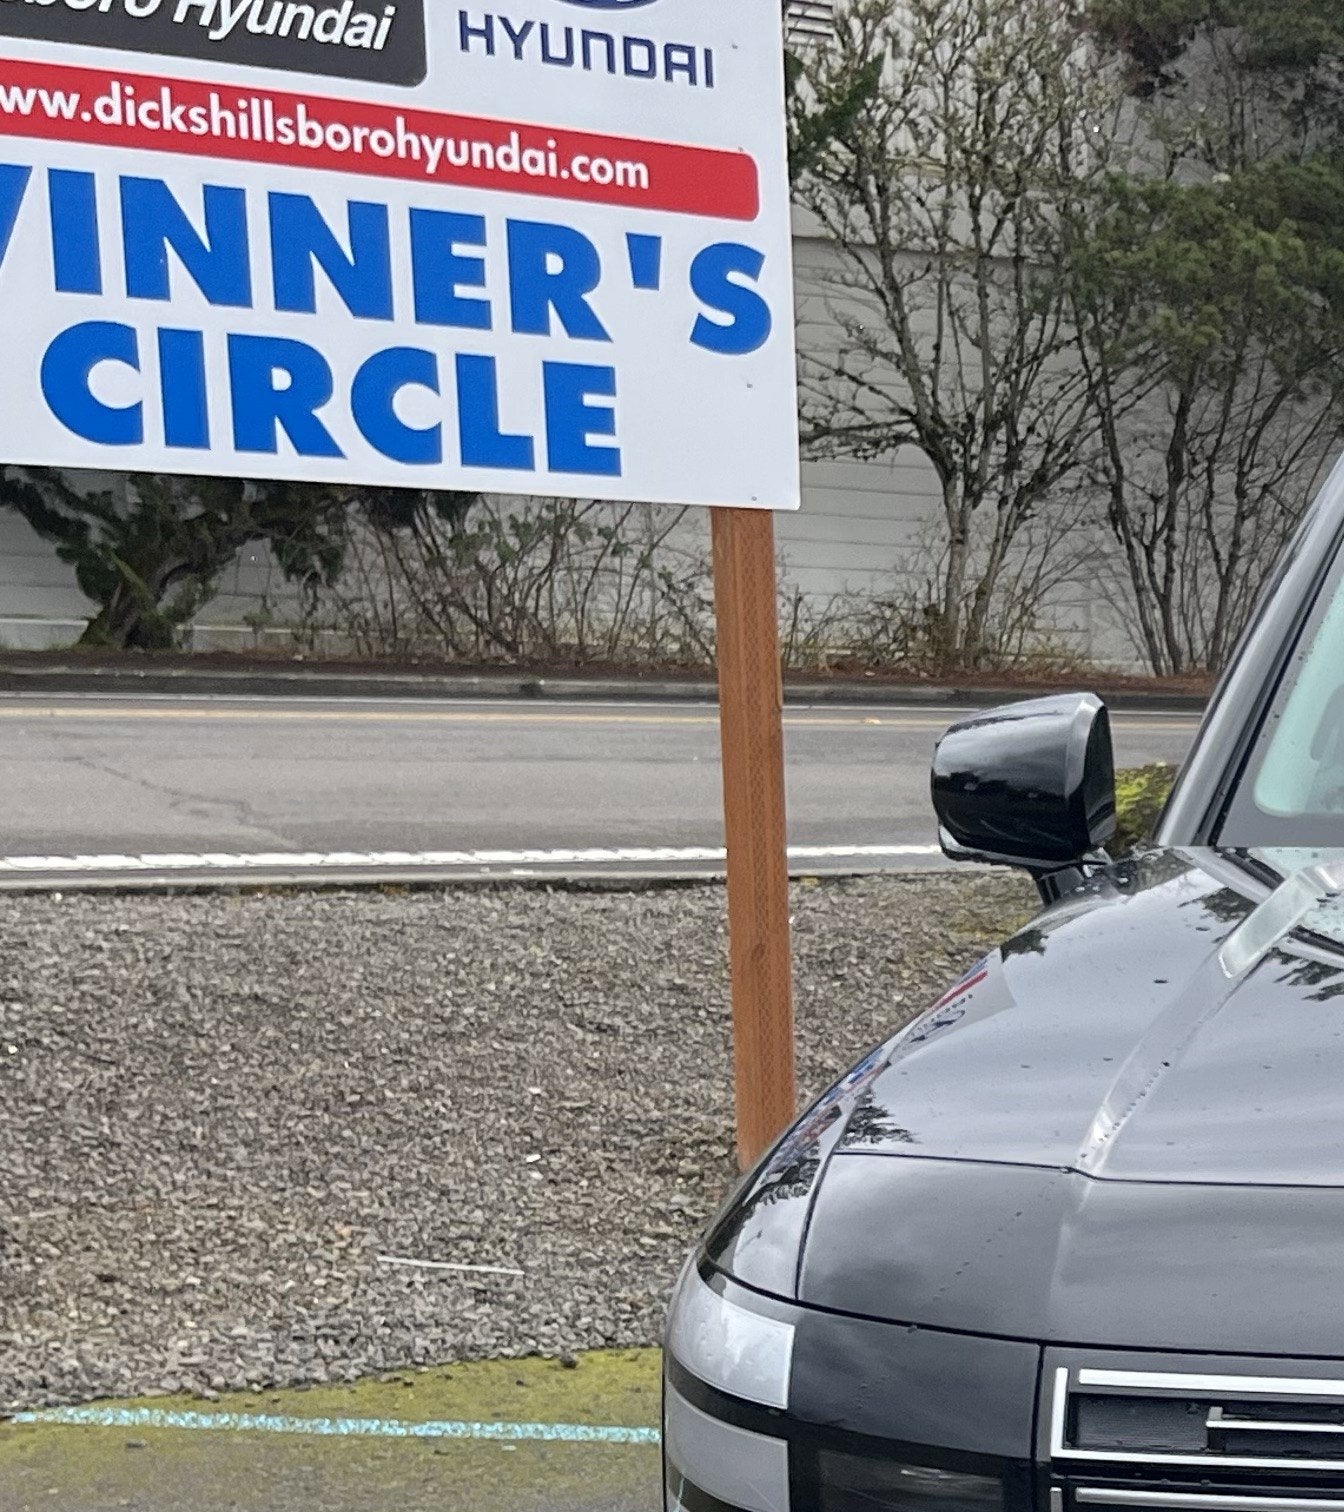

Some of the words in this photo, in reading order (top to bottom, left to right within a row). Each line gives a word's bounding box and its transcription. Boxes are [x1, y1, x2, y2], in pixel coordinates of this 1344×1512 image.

[458, 9, 715, 88] HYUNDAI
[0, 163, 771, 353] INNER'S
[40, 319, 620, 475] CIRCLE
